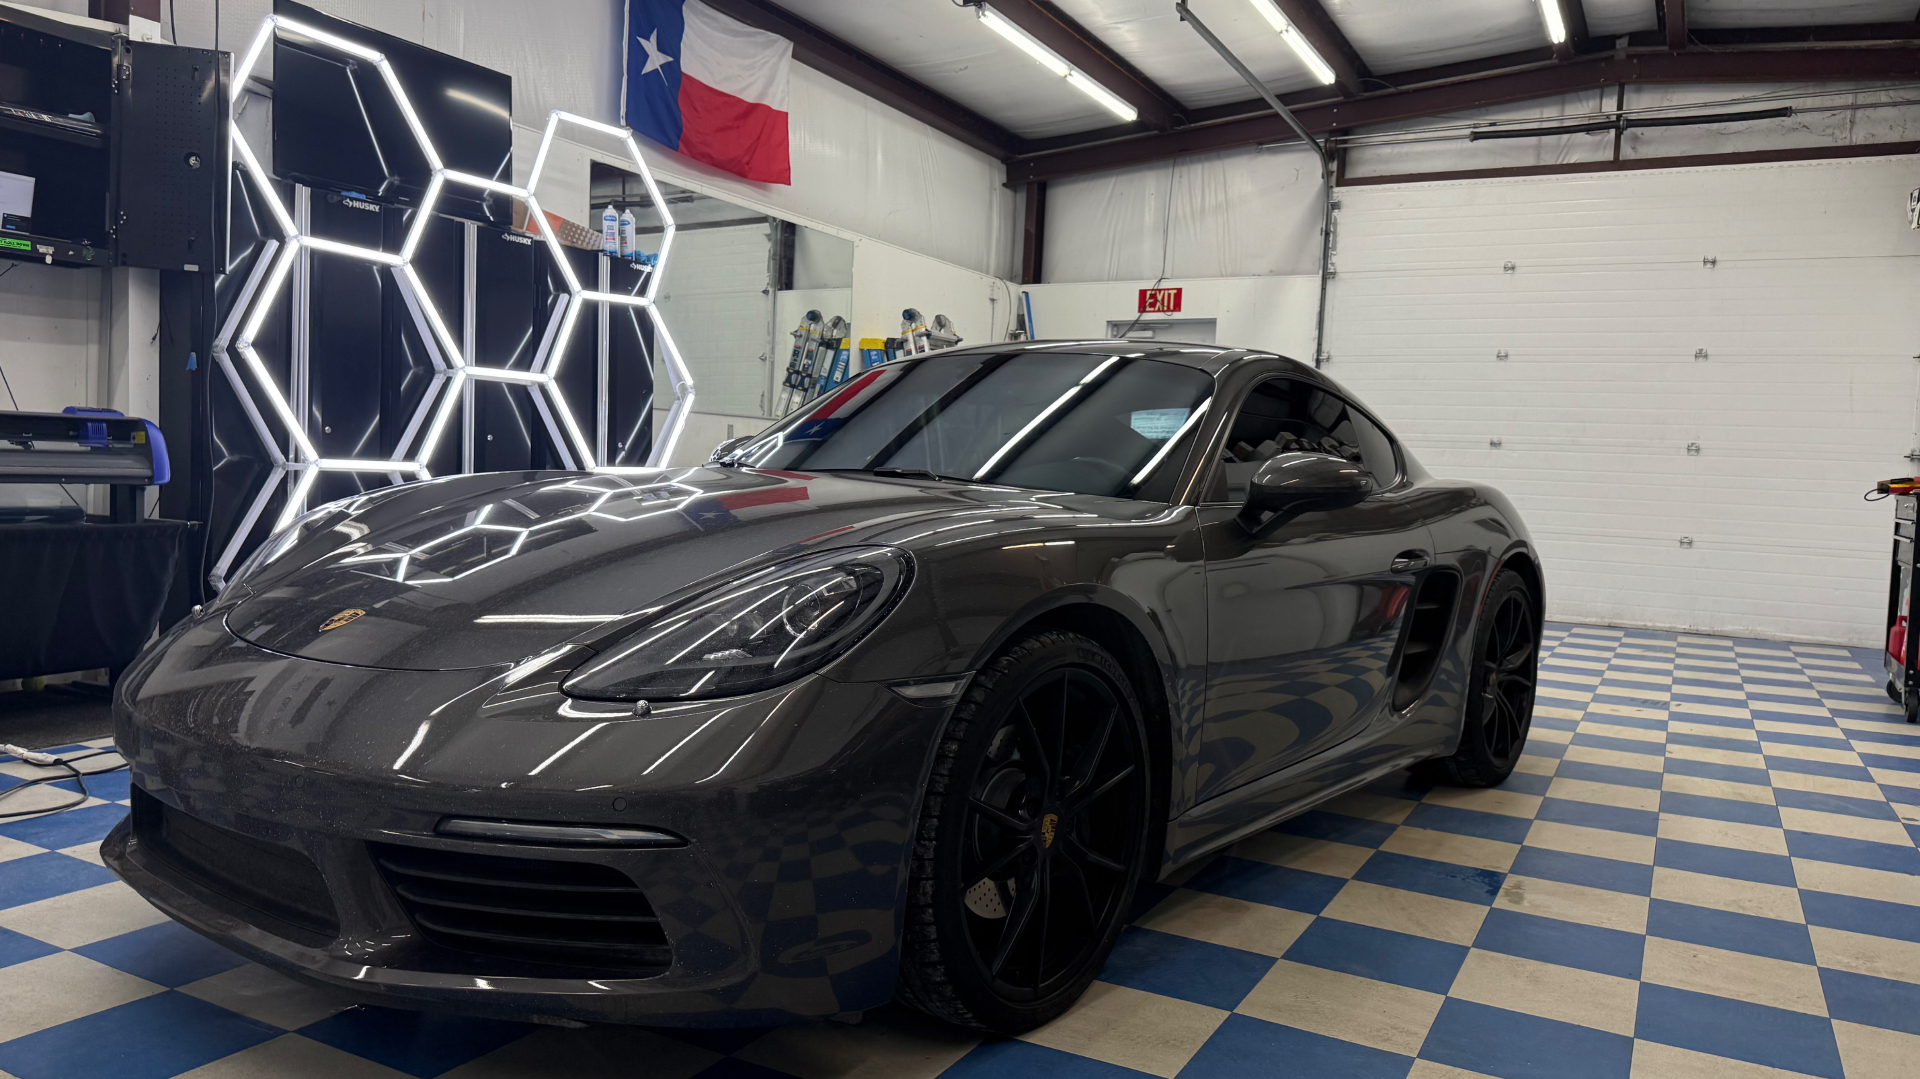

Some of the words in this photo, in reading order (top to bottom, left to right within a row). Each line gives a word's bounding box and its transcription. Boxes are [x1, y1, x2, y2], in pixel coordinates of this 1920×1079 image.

[353, 200, 380, 212] HUSKY
[510, 235, 532, 245] HUSKY
[1146, 289, 1177, 311] EXIT
